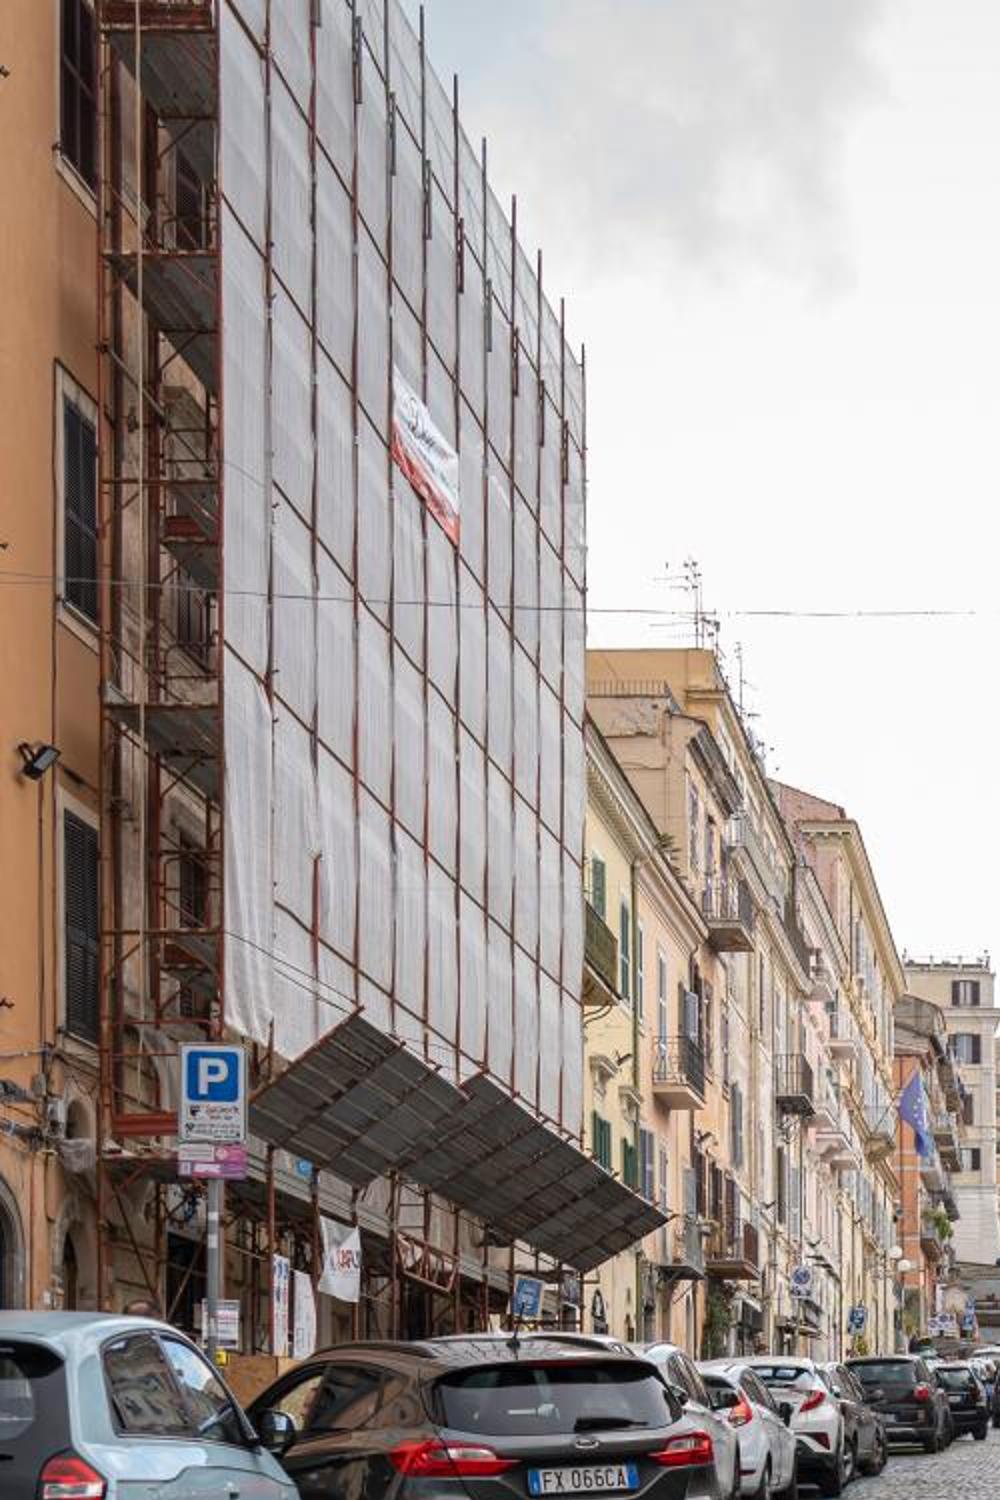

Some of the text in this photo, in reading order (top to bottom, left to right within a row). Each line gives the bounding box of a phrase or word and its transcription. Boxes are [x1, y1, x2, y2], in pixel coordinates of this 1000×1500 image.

[198, 1057, 229, 1095] P
[542, 1468, 627, 1490] FX 066CA
